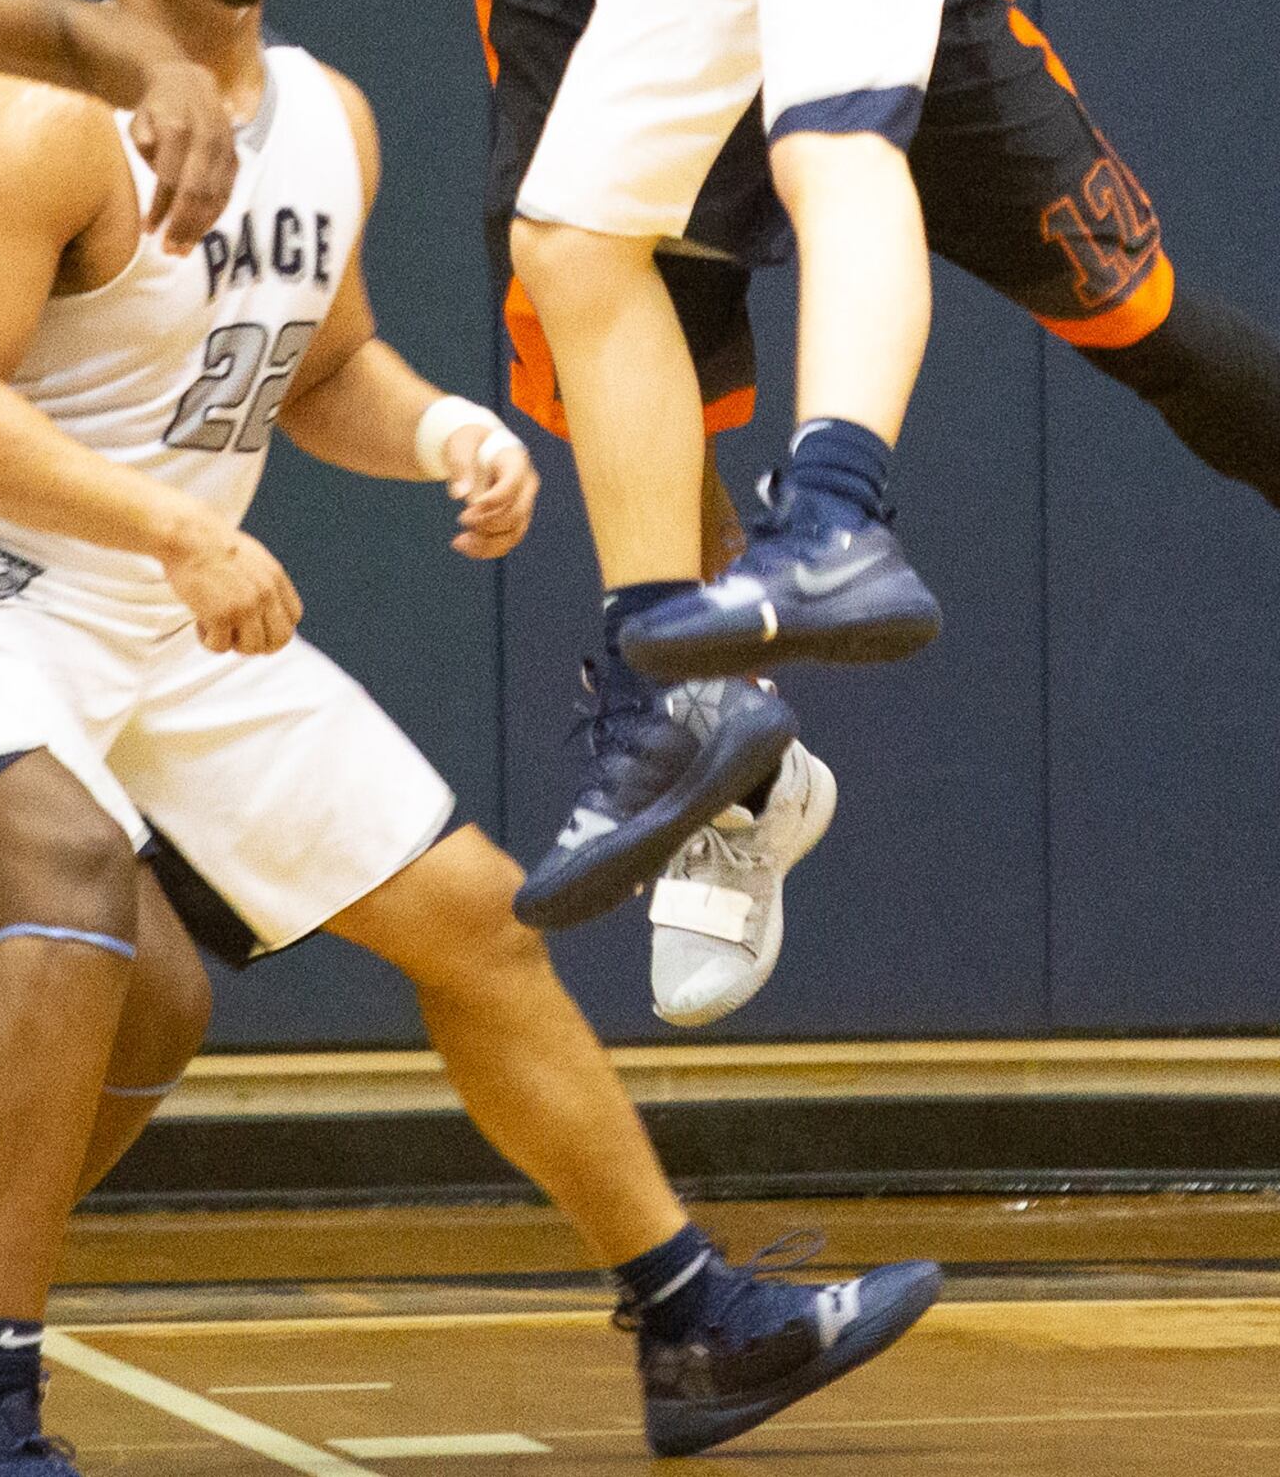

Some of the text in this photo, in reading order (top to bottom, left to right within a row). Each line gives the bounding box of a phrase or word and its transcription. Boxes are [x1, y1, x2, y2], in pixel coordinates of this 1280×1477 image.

[203, 206, 331, 301] PACE
[1040, 157, 1161, 310] 12
[162, 322, 318, 453] 22
